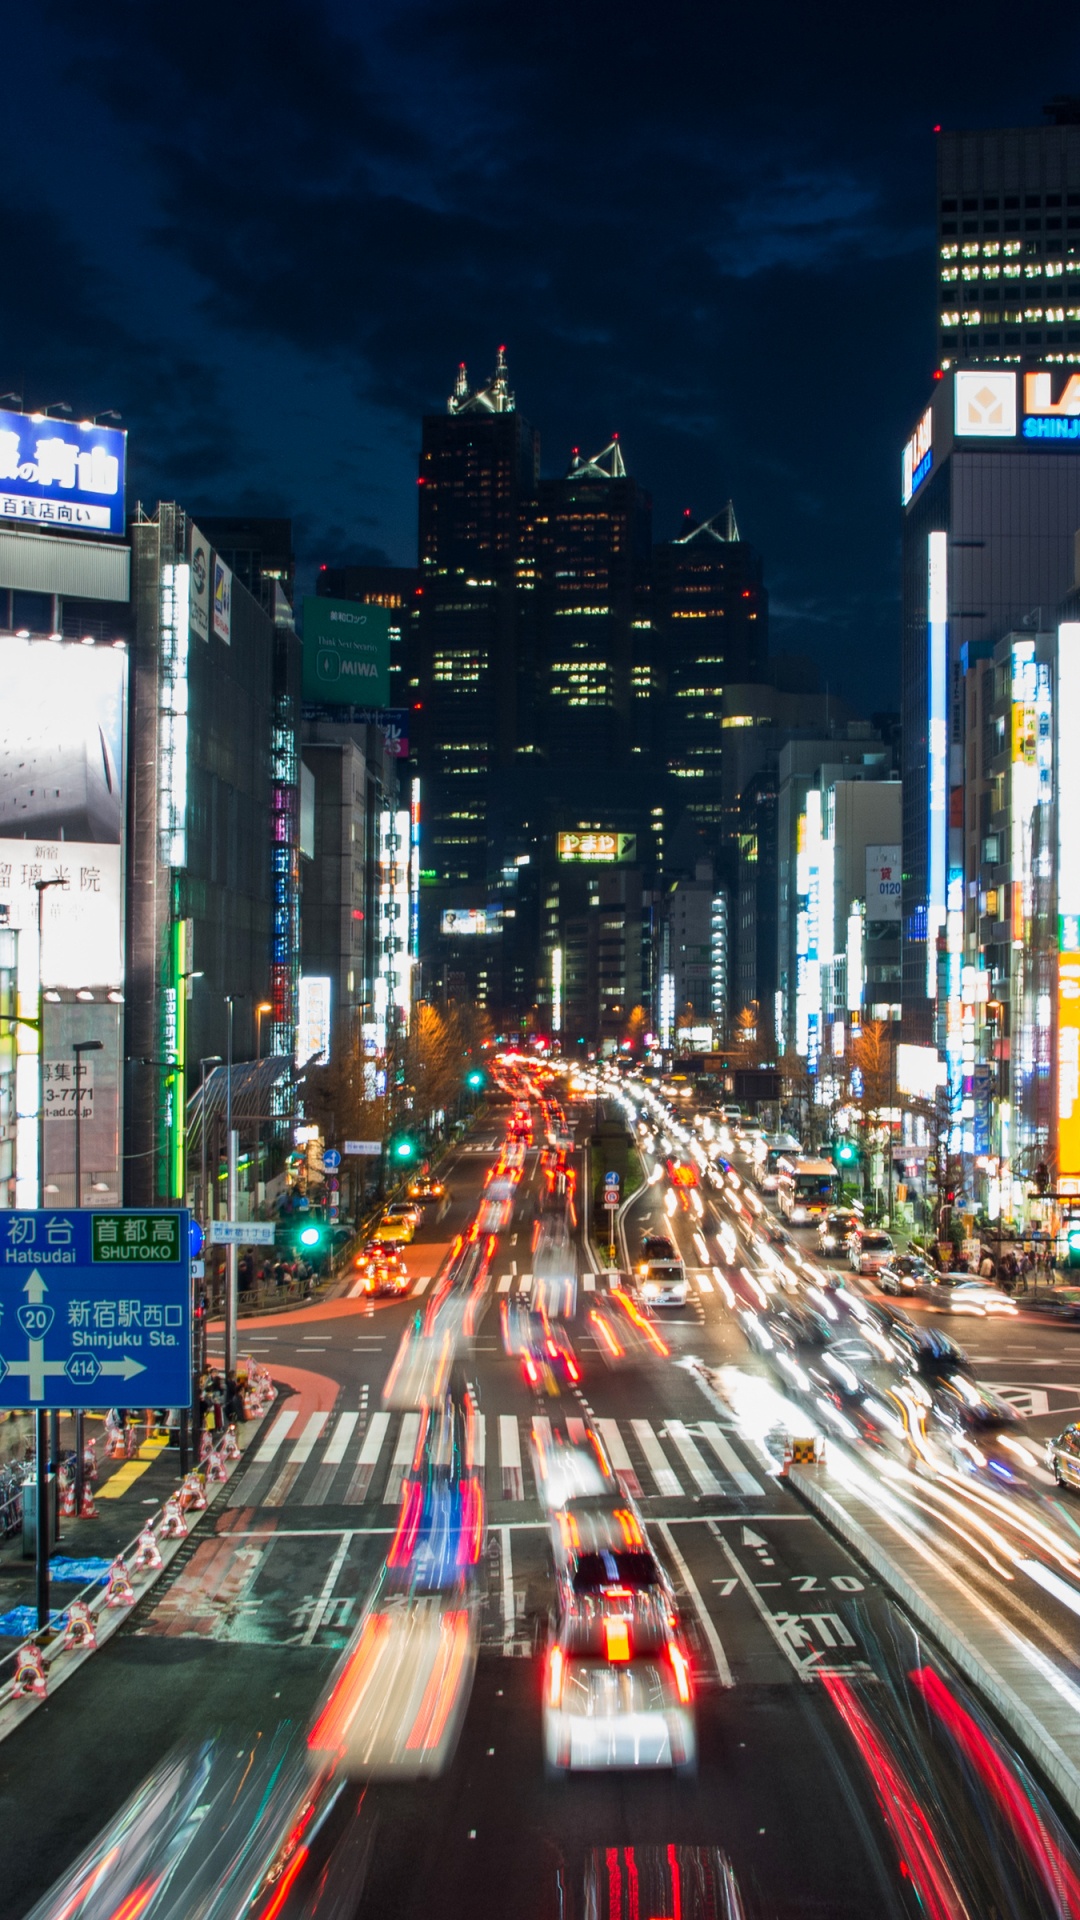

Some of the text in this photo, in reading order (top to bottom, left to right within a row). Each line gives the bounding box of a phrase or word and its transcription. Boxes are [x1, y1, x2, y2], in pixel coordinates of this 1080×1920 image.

[1023, 417, 1080, 439] SHINJ
[3, 497, 91, 522] 百貨店向い
[329, 610, 368, 625] 美和ロック
[318, 636, 336, 647] Think
[353, 641, 378, 653] Security
[341, 660, 379, 678] MIWA
[35, 845, 59, 860] 新宿
[563, 834, 615, 853] やまや
[880, 883, 901, 895] 0120
[7, 1216, 176, 1245] 初台 首都高
[5, 1246, 172, 1264] Hatsudai SHUTOKO
[25, 1311, 47, 1329] 20
[68, 1299, 183, 1328] 新宿駅西口
[72, 1331, 180, 1349] Shinjuku Sta.
[70, 1360, 96, 1377] 414
